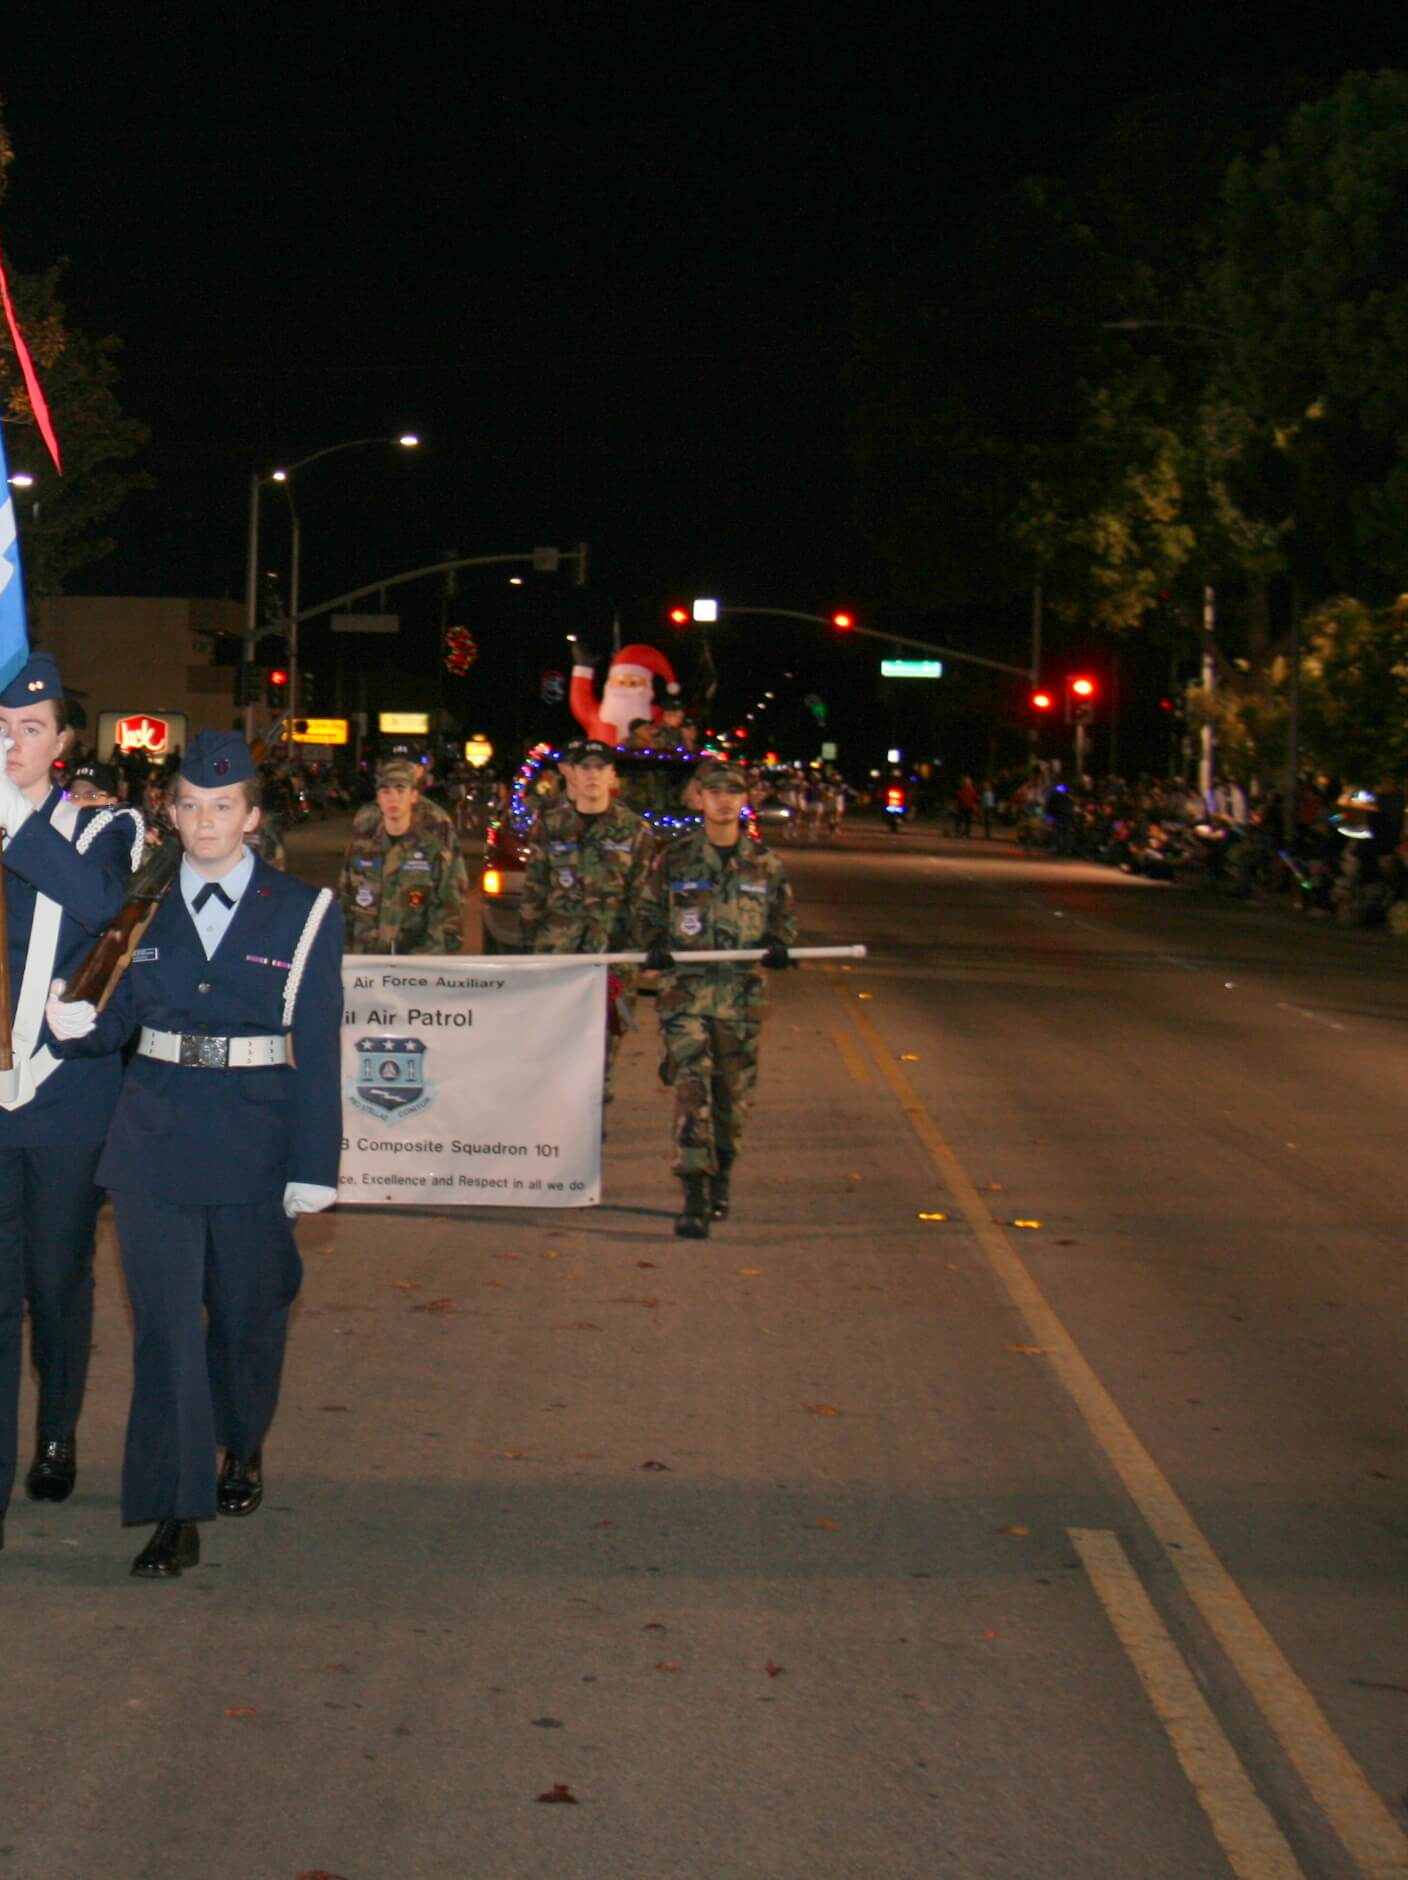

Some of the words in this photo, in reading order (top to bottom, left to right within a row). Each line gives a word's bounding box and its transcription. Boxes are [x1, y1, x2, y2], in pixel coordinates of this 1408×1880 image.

[353, 976, 375, 990] Air
[382, 975, 429, 988] Force
[435, 976, 505, 990] Auxiliary
[367, 1008, 398, 1026] Air
[407, 1008, 473, 1028] Patrol
[357, 1137, 445, 1155] Composite
[451, 1139, 528, 1157] Squadron
[535, 1143, 560, 1158] 101
[361, 1172, 428, 1187] Excellence
[431, 1174, 454, 1187] and
[458, 1174, 508, 1190] Respect
[512, 1177, 524, 1189] in
[528, 1179, 543, 1191] all
[547, 1182, 565, 1192] we
[568, 1180, 586, 1192] do
